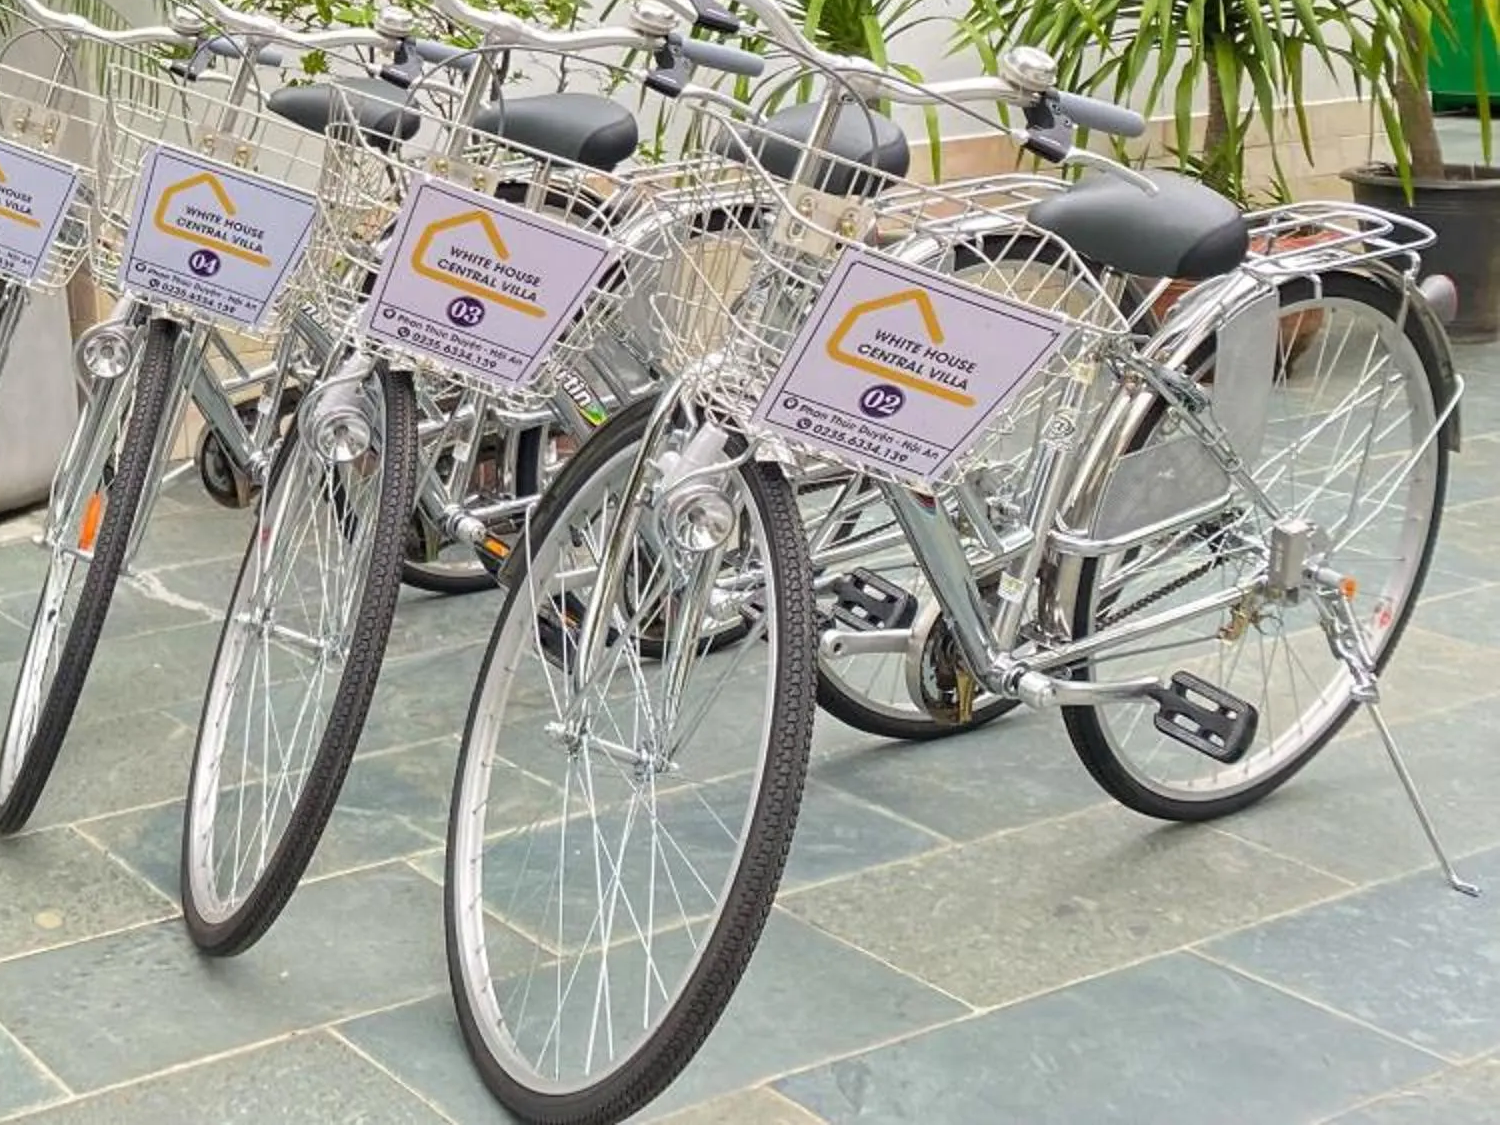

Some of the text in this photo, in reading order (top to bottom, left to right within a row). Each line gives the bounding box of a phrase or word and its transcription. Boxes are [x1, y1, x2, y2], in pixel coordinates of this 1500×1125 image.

[5, 200, 33, 215] VILLA
[186, 206, 265, 240] WHITE HOUSE
[176, 217, 264, 254] CENTRAL VILLA
[191, 253, 218, 273] 04
[437, 258, 537, 302] CENTRAL VILLA
[451, 246, 541, 287] WHITE HOUSE
[451, 300, 483, 324] 03
[858, 344, 968, 391] CENTRAL VILLA
[875, 329, 977, 374] WHITE HOUSE
[864, 389, 900, 414] 02
